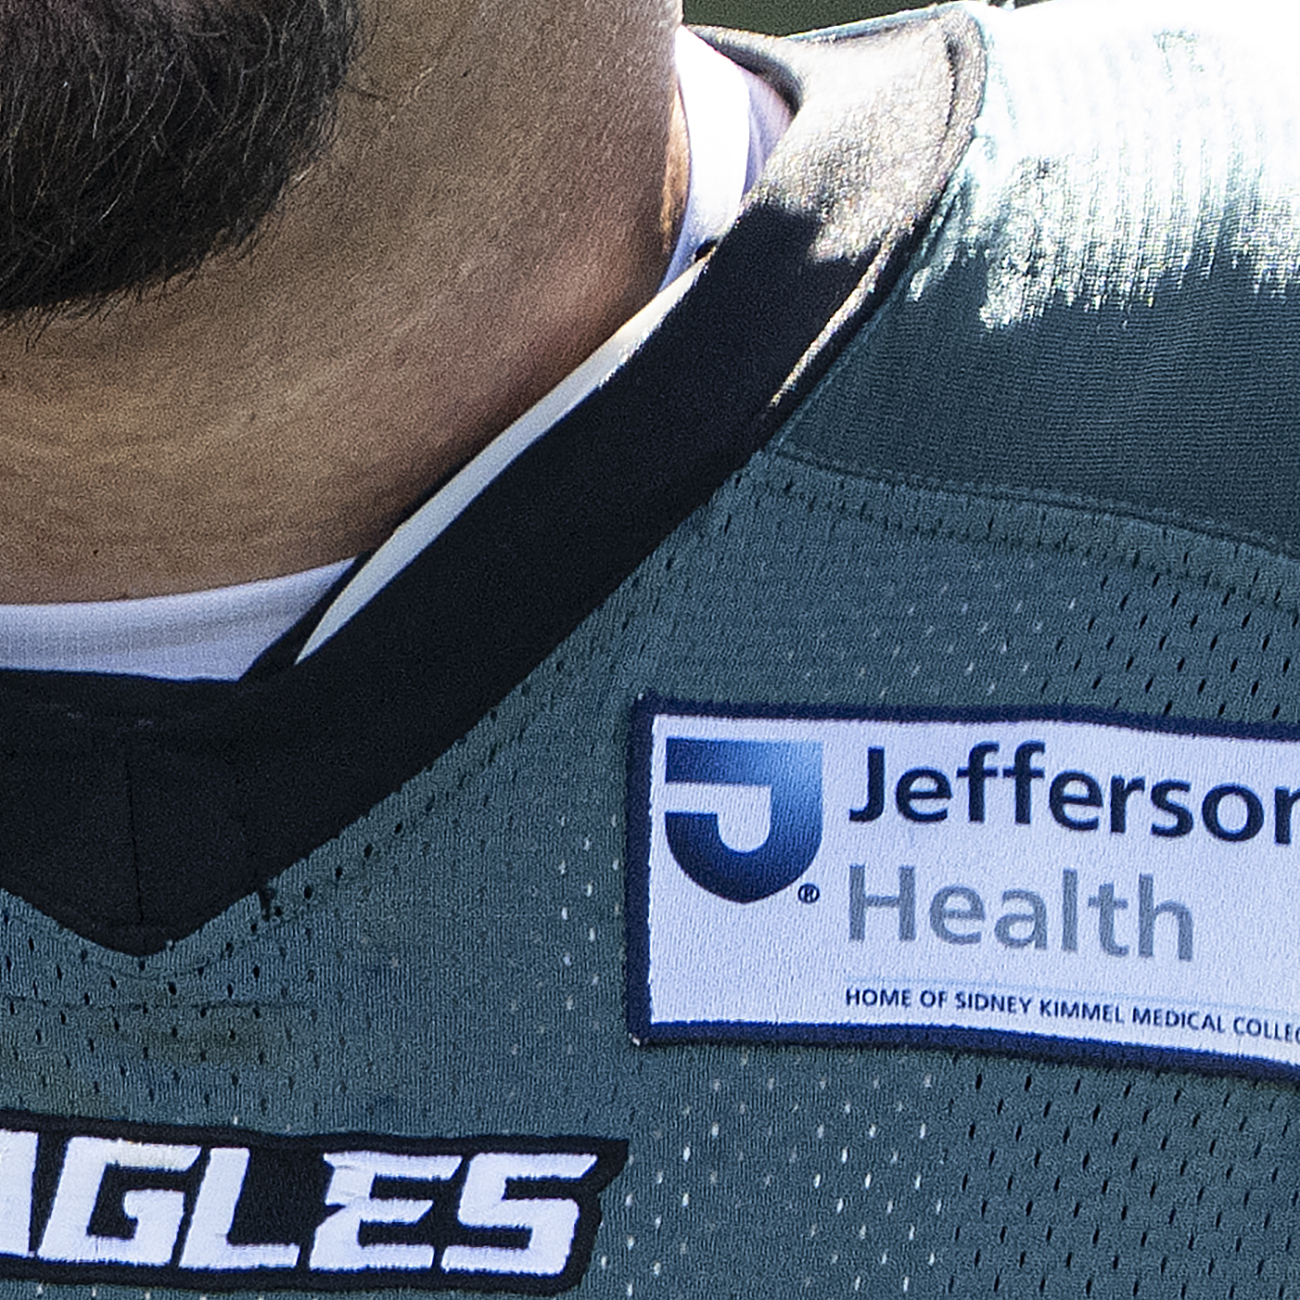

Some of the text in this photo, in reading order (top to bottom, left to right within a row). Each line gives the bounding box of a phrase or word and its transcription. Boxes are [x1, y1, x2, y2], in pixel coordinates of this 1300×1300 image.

[847, 864, 1195, 963] Health
[845, 987, 912, 1008] HOME
[919, 989, 949, 1009] OF
[954, 991, 1033, 1015] SIDNEY
[1039, 998, 1125, 1024] KIMMEL
[1132, 1006, 1226, 1034] MEDICAL
